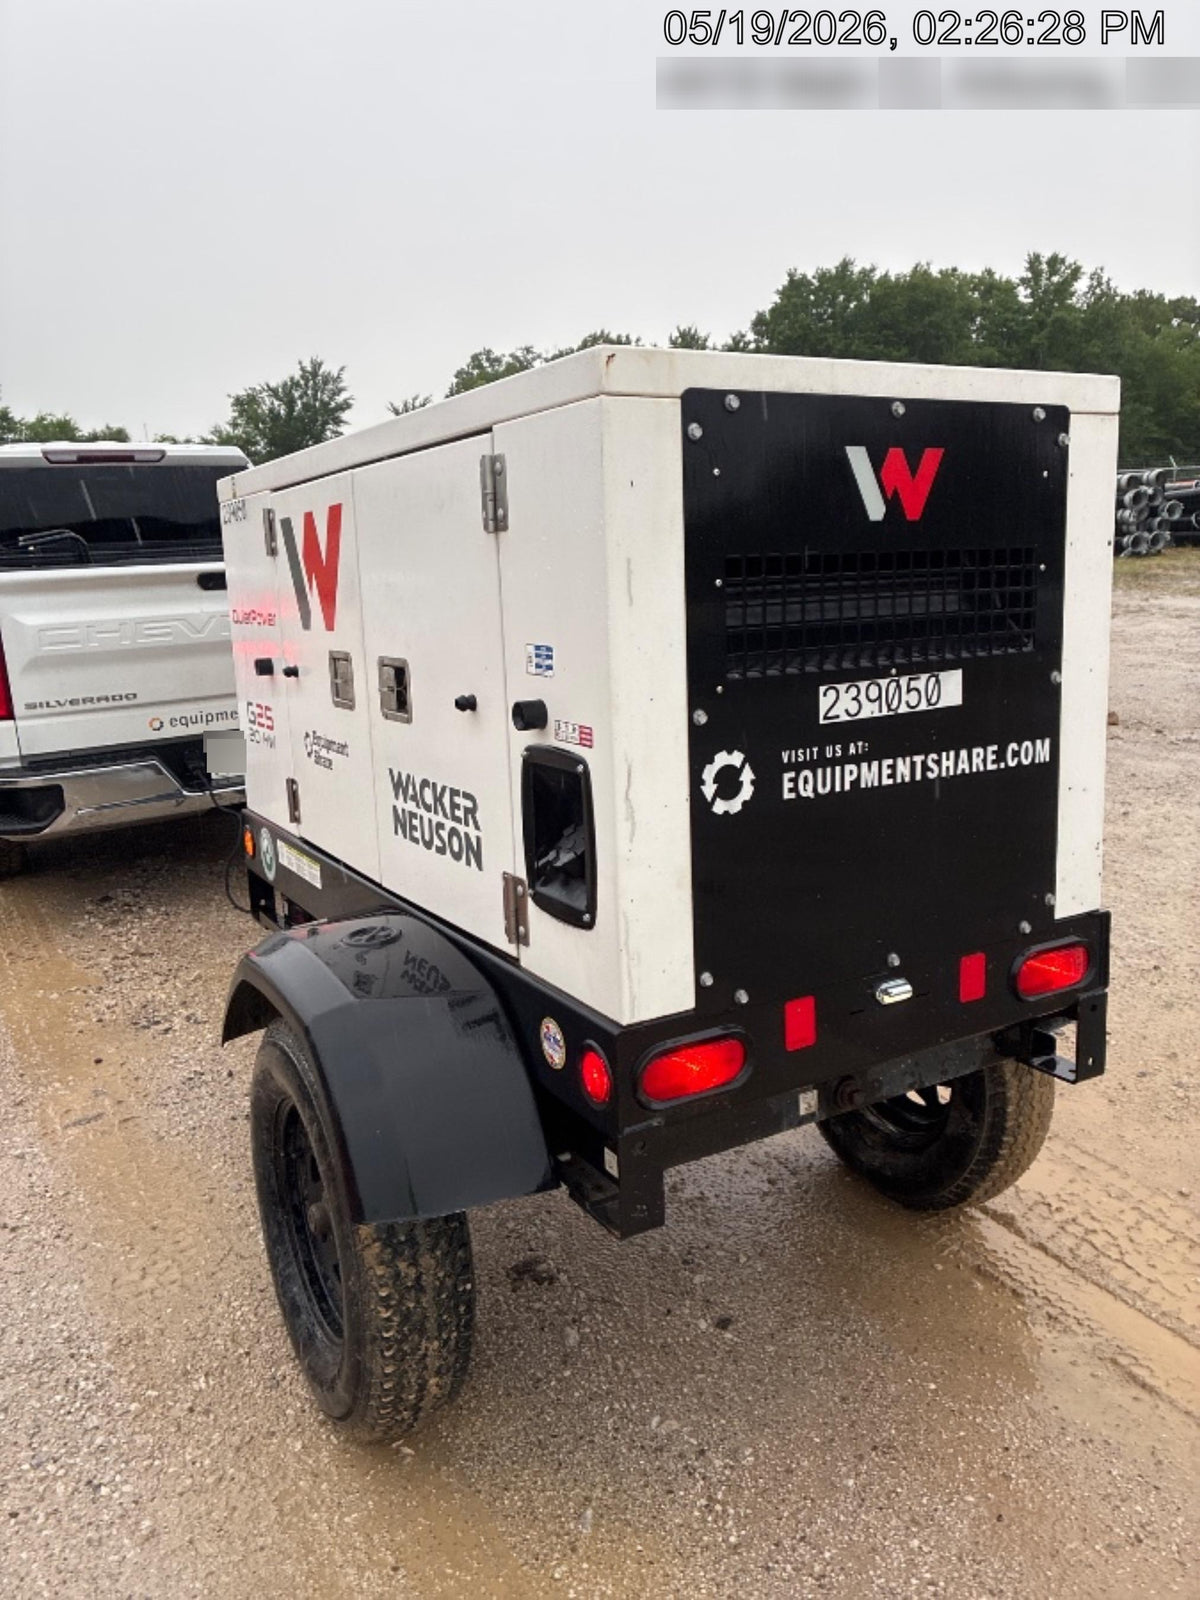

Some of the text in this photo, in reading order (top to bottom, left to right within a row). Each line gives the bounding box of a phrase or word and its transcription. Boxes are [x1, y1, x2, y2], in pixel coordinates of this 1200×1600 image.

[38, 614, 229, 651] CHEV
[24, 692, 137, 710] SILVERADO
[247, 701, 274, 731] G25
[821, 673, 942, 720] 239050
[781, 741, 869, 764] VISIT US AT:
[782, 738, 1051, 801] EQUIPMENTSHARE.COM
[388, 767, 481, 832] WACKER
[392, 804, 483, 871] NEUSON
